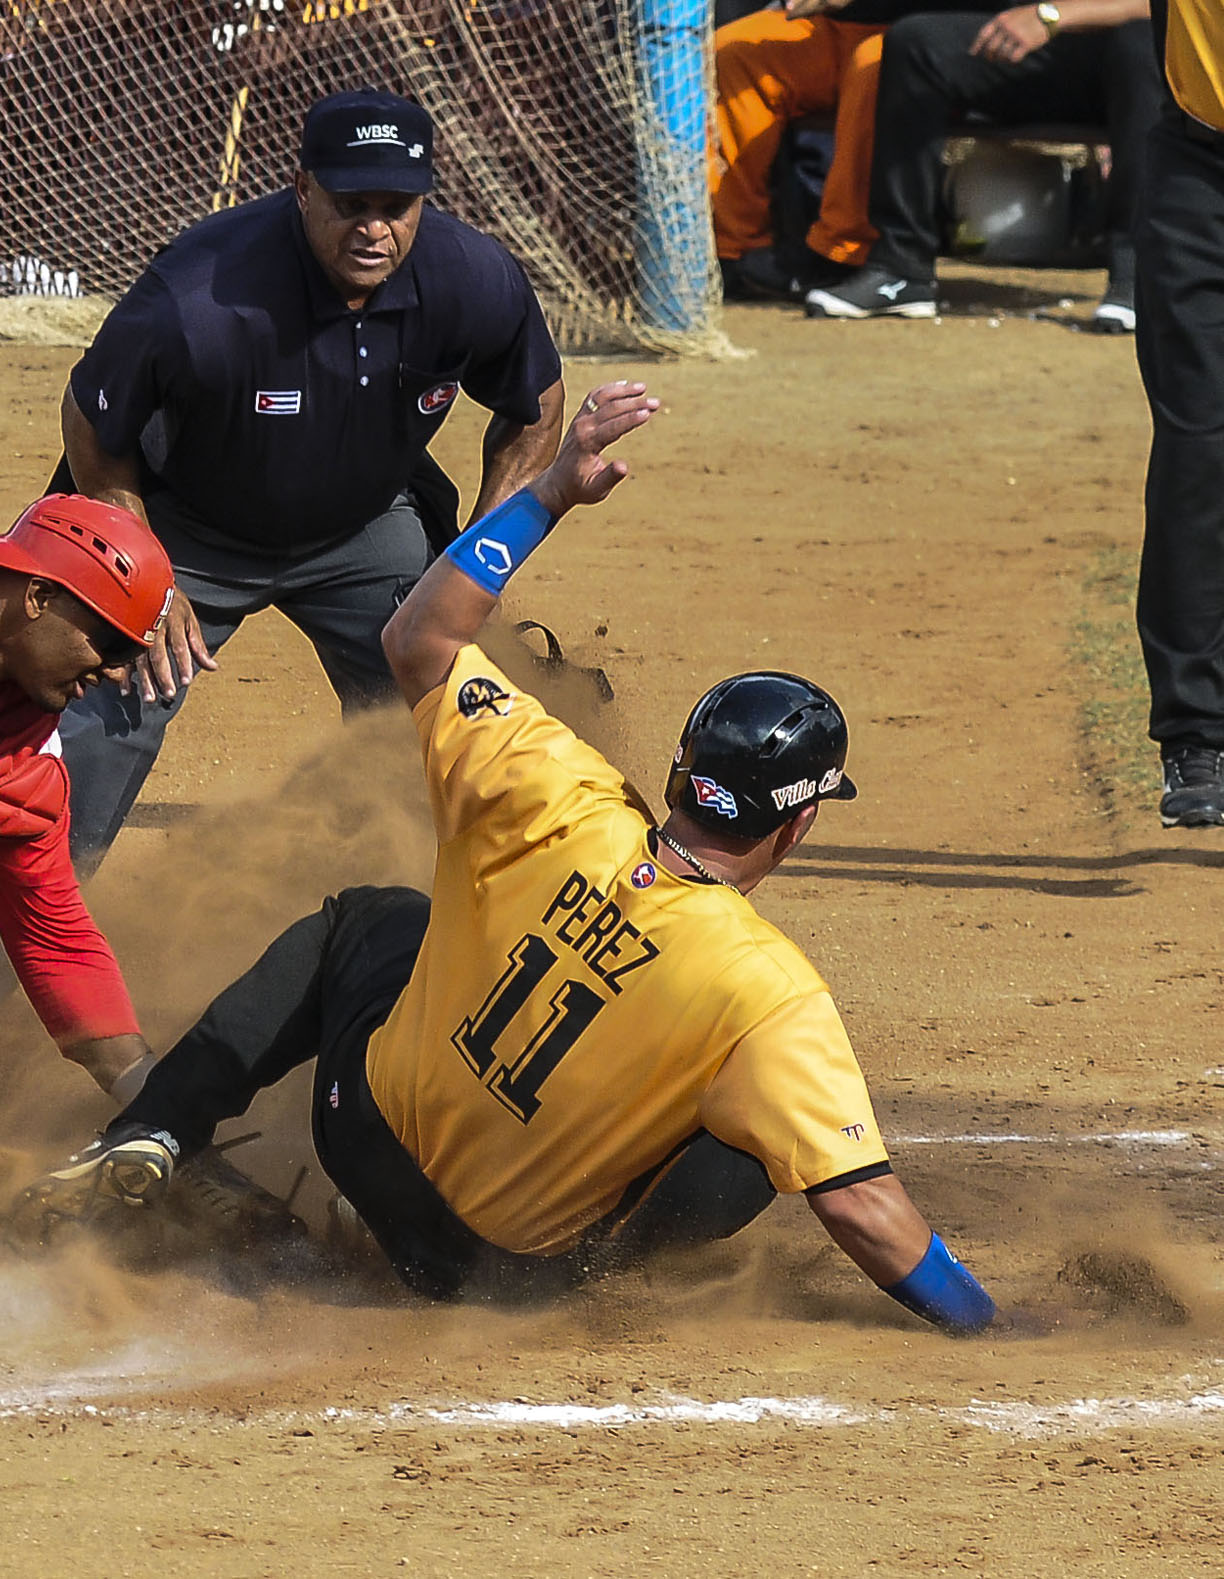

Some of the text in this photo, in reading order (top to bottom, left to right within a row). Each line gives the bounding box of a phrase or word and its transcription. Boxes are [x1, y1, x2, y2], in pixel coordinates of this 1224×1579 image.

[355, 124, 399, 139] WBSC
[771, 778, 817, 811] Villa
[541, 869, 662, 997] PEREZ
[450, 932, 607, 1127] 11
